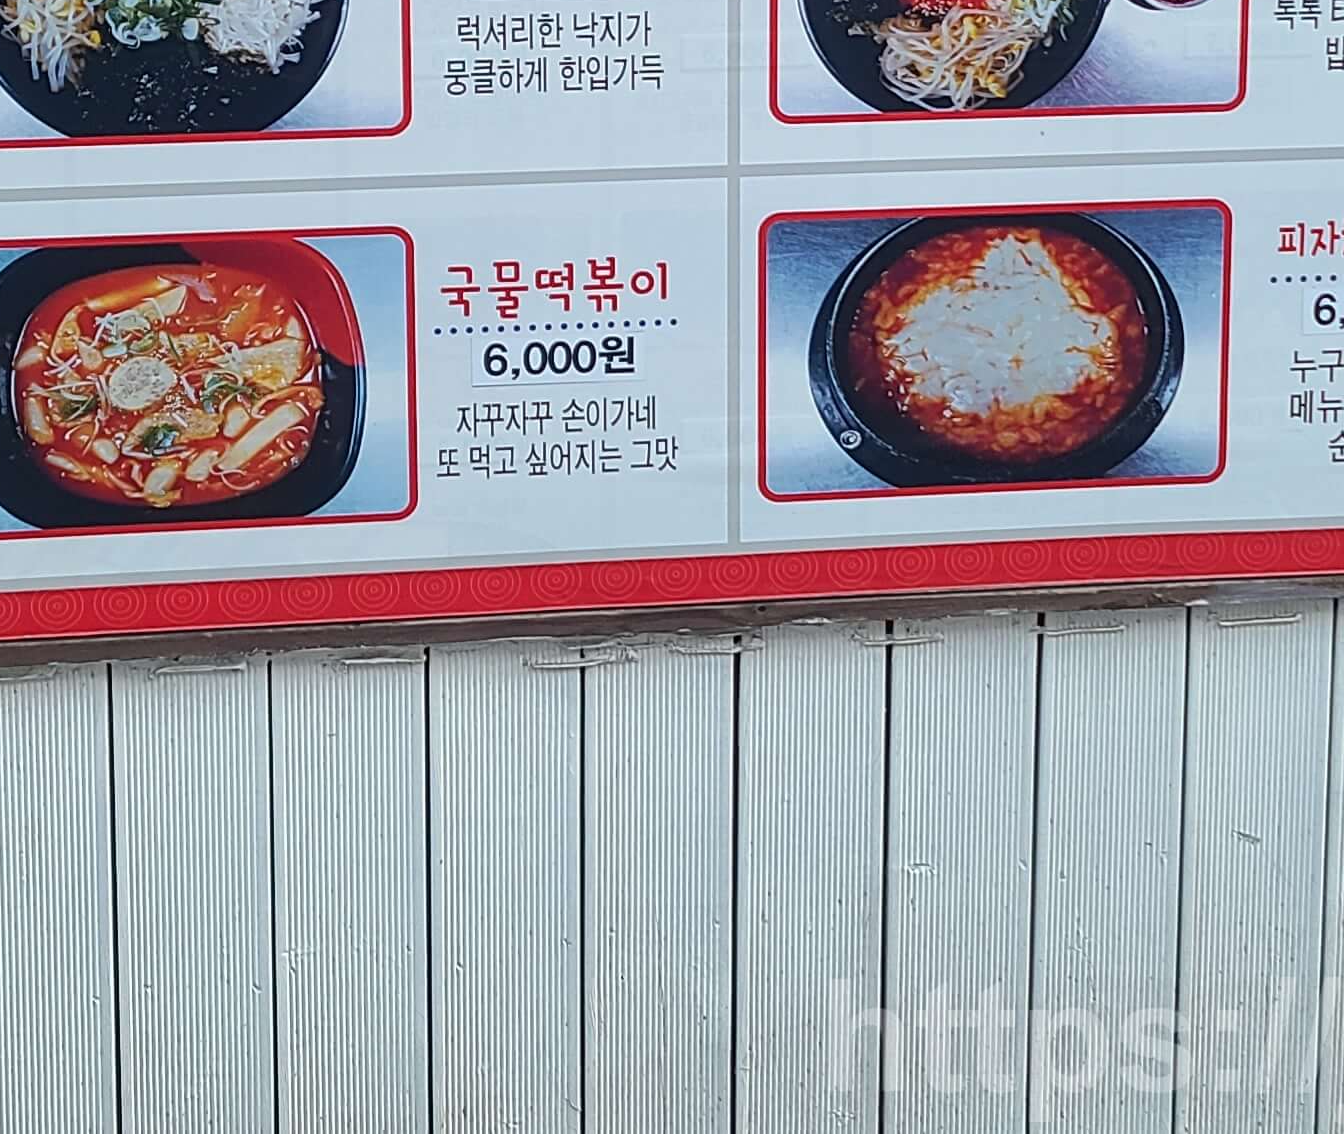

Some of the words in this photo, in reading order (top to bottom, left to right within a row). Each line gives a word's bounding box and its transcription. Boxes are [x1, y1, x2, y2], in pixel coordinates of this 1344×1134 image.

[456, 12, 564, 52] 럭셔리한
[572, 10, 653, 49] 낙지가
[442, 56, 549, 97] 뭉클하게
[558, 53, 665, 93] 한입가득
[439, 256, 669, 320] 국물떡볶이
[482, 335, 636, 381] 6,000원
[455, 400, 554, 439] 자꾸자꾸
[561, 395, 658, 434] 손이가네
[1289, 389, 1344, 424] 메뉴
[436, 447, 462, 479] 또
[469, 443, 518, 481] 먹고
[524, 439, 623, 477] 싶어지는
[628, 434, 680, 473] 그맛
